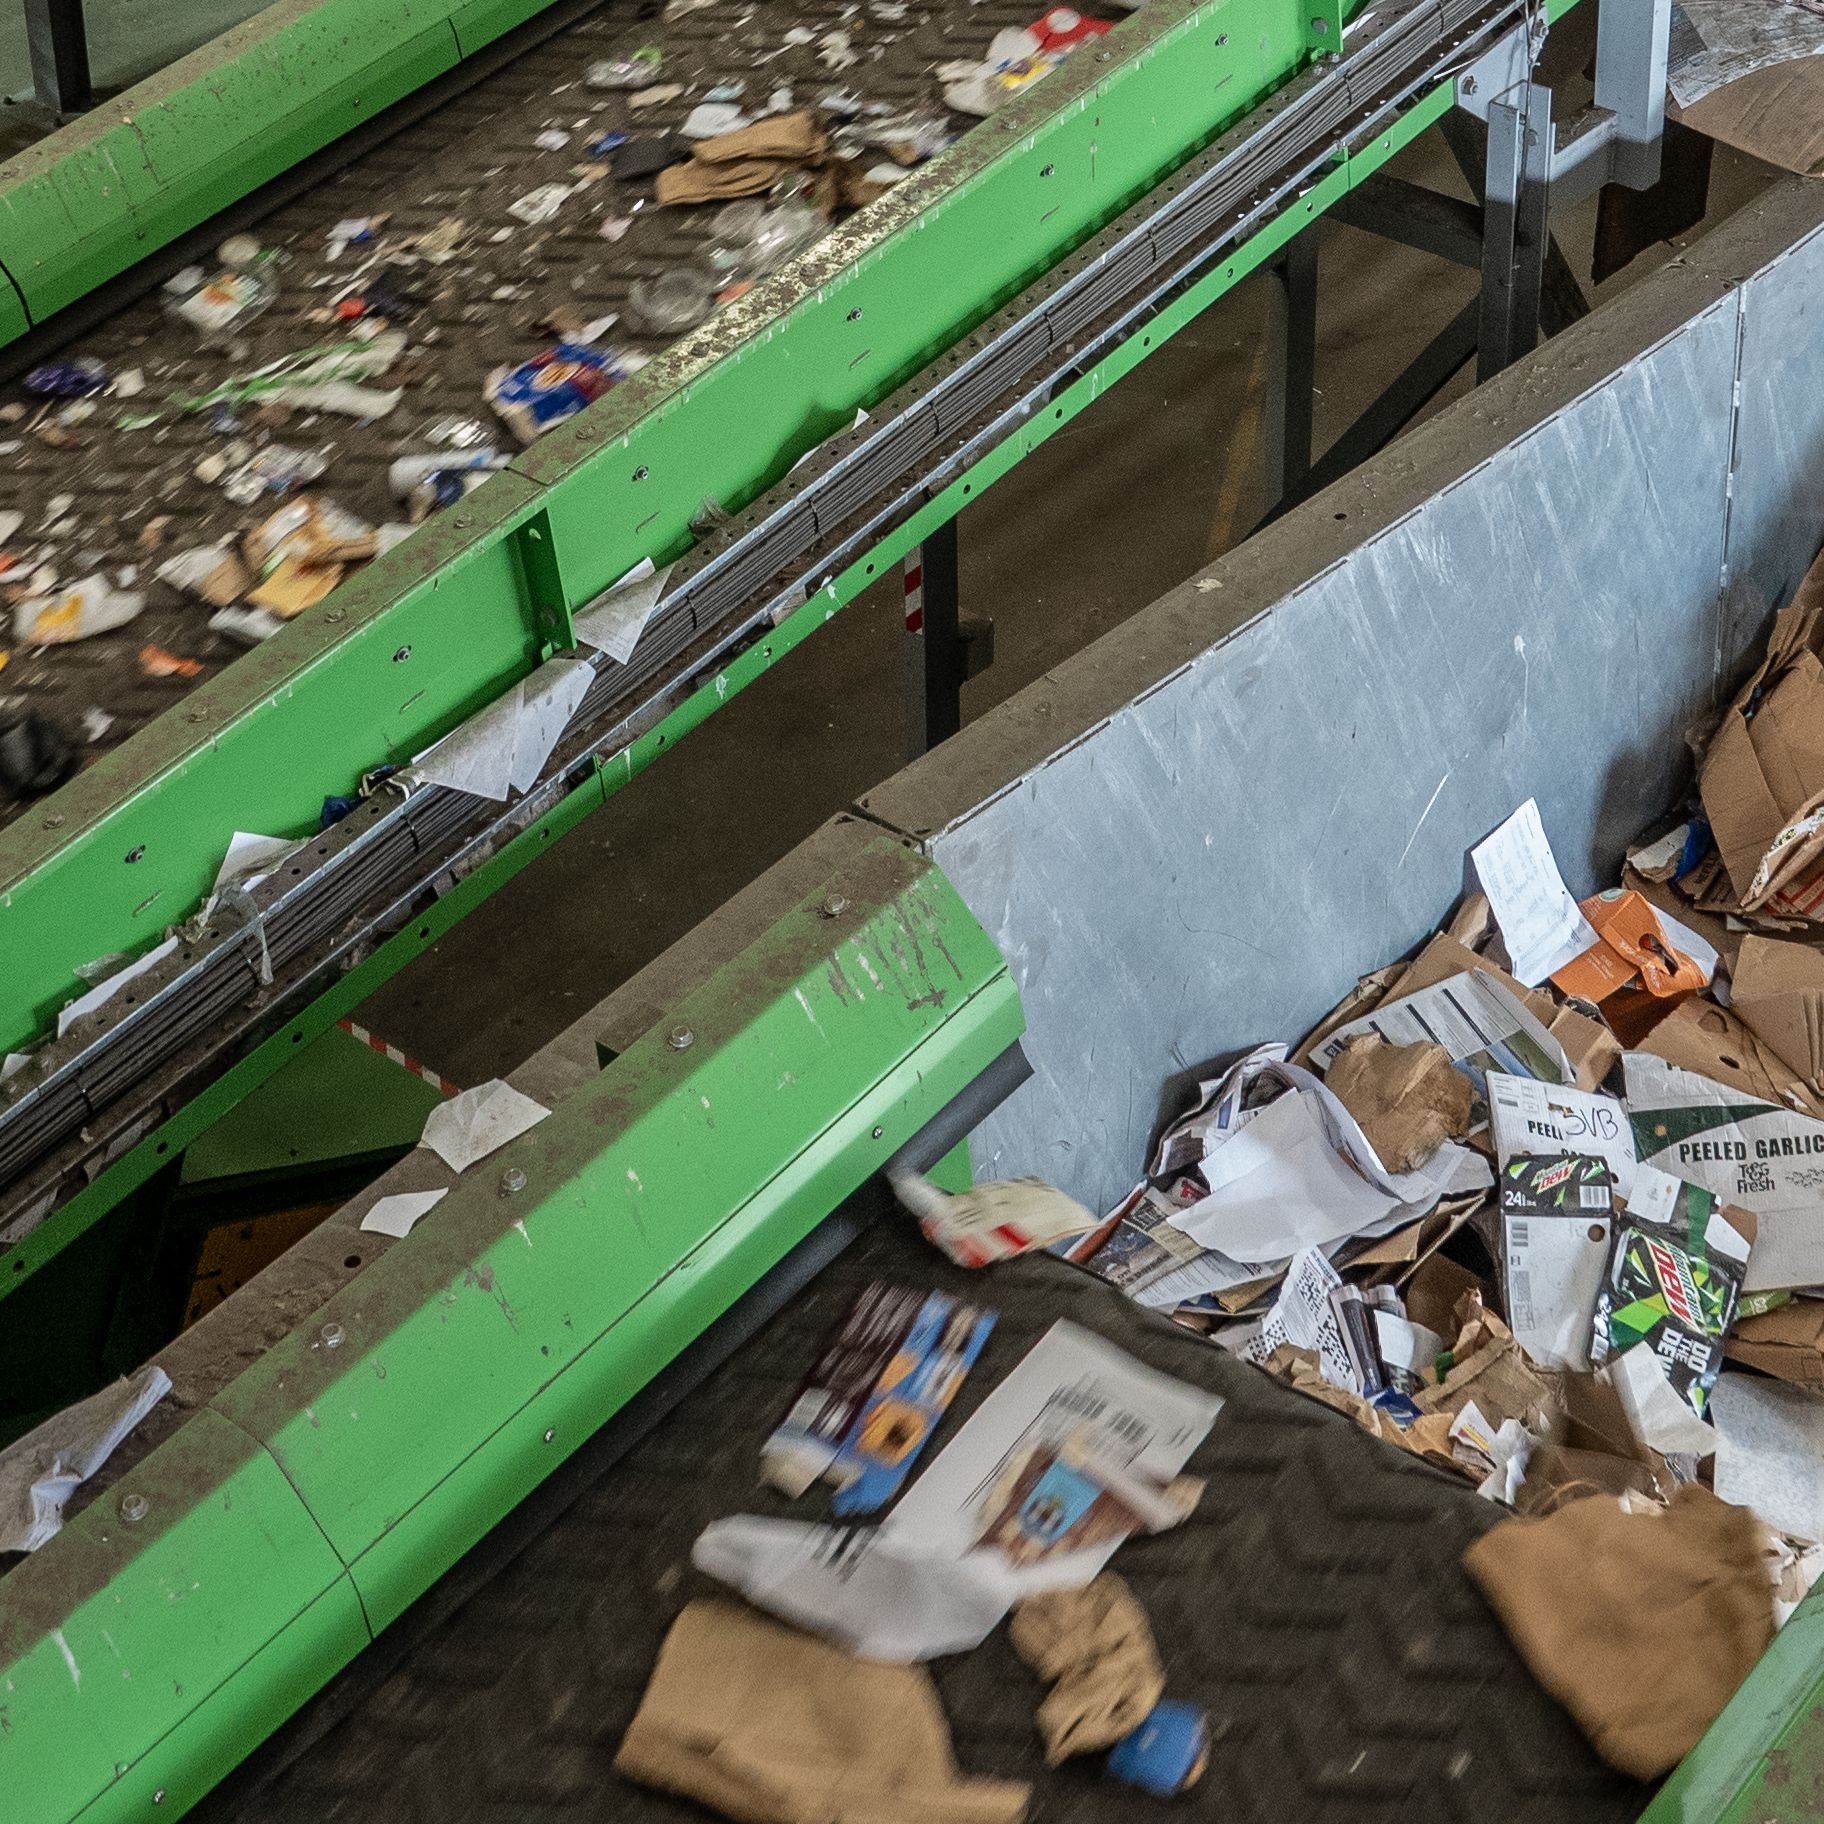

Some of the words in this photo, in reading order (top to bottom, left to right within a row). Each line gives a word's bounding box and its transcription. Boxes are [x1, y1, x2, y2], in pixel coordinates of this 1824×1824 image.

[1679, 1141, 1747, 1164] PEELED
[1737, 1177, 1776, 1195] Fresh
[1504, 1190, 1522, 1207] 24
[1676, 1333, 1694, 1366] THE
[1686, 1338, 1712, 1375] DO
